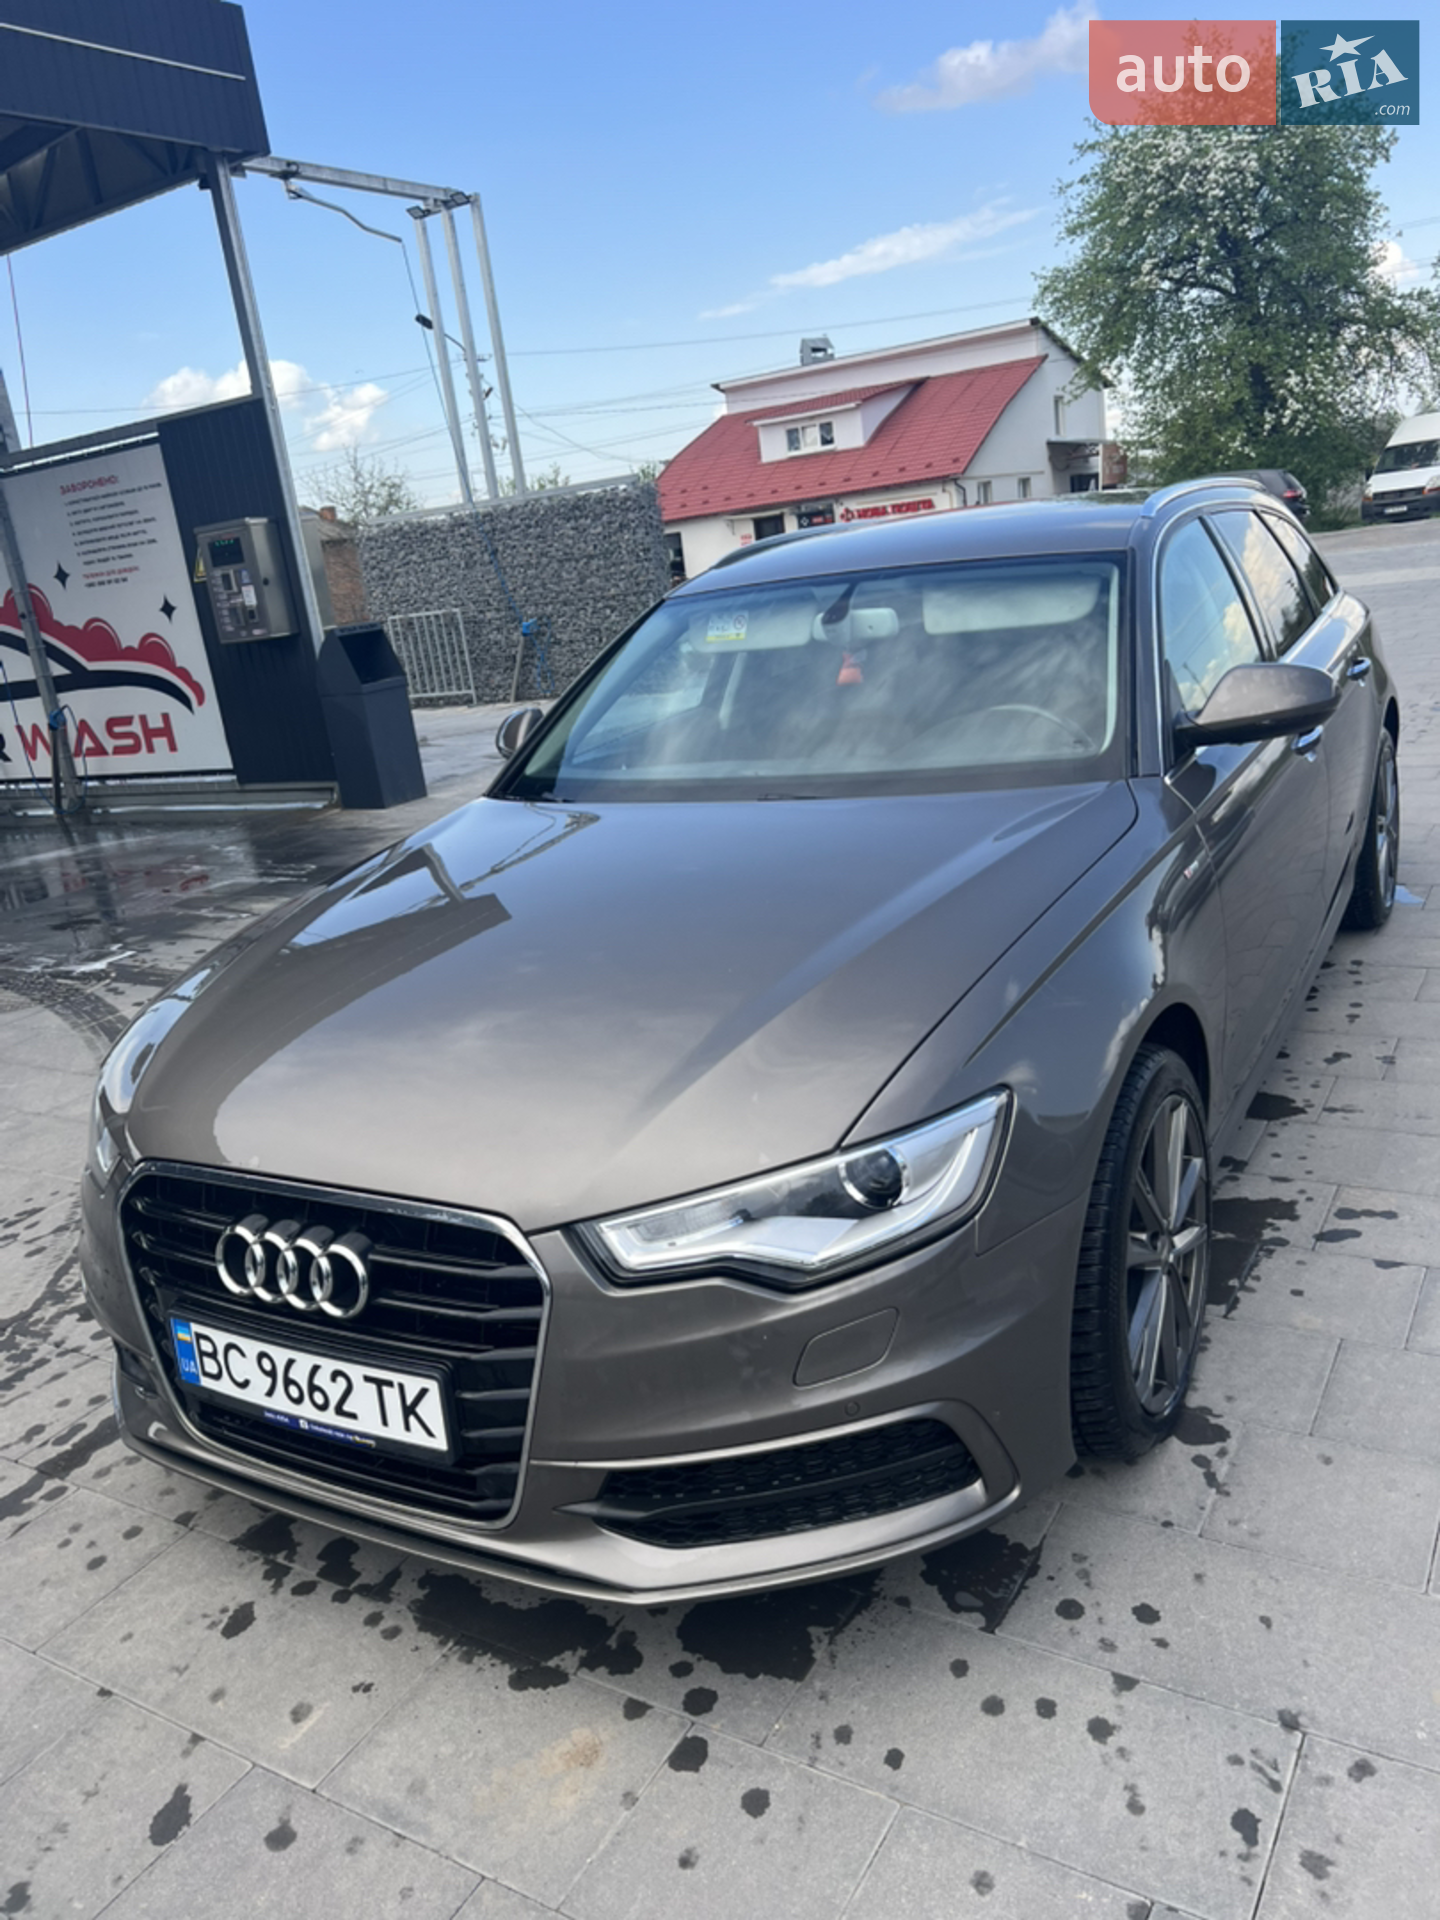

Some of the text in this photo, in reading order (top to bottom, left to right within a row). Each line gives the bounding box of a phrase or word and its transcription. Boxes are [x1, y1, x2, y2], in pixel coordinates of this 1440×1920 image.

[15, 712, 178, 761] WASH
[180, 1357, 198, 1376] UA
[193, 1330, 251, 1389] BC
[256, 1350, 358, 1420] 9662
[362, 1374, 437, 1438] TK
